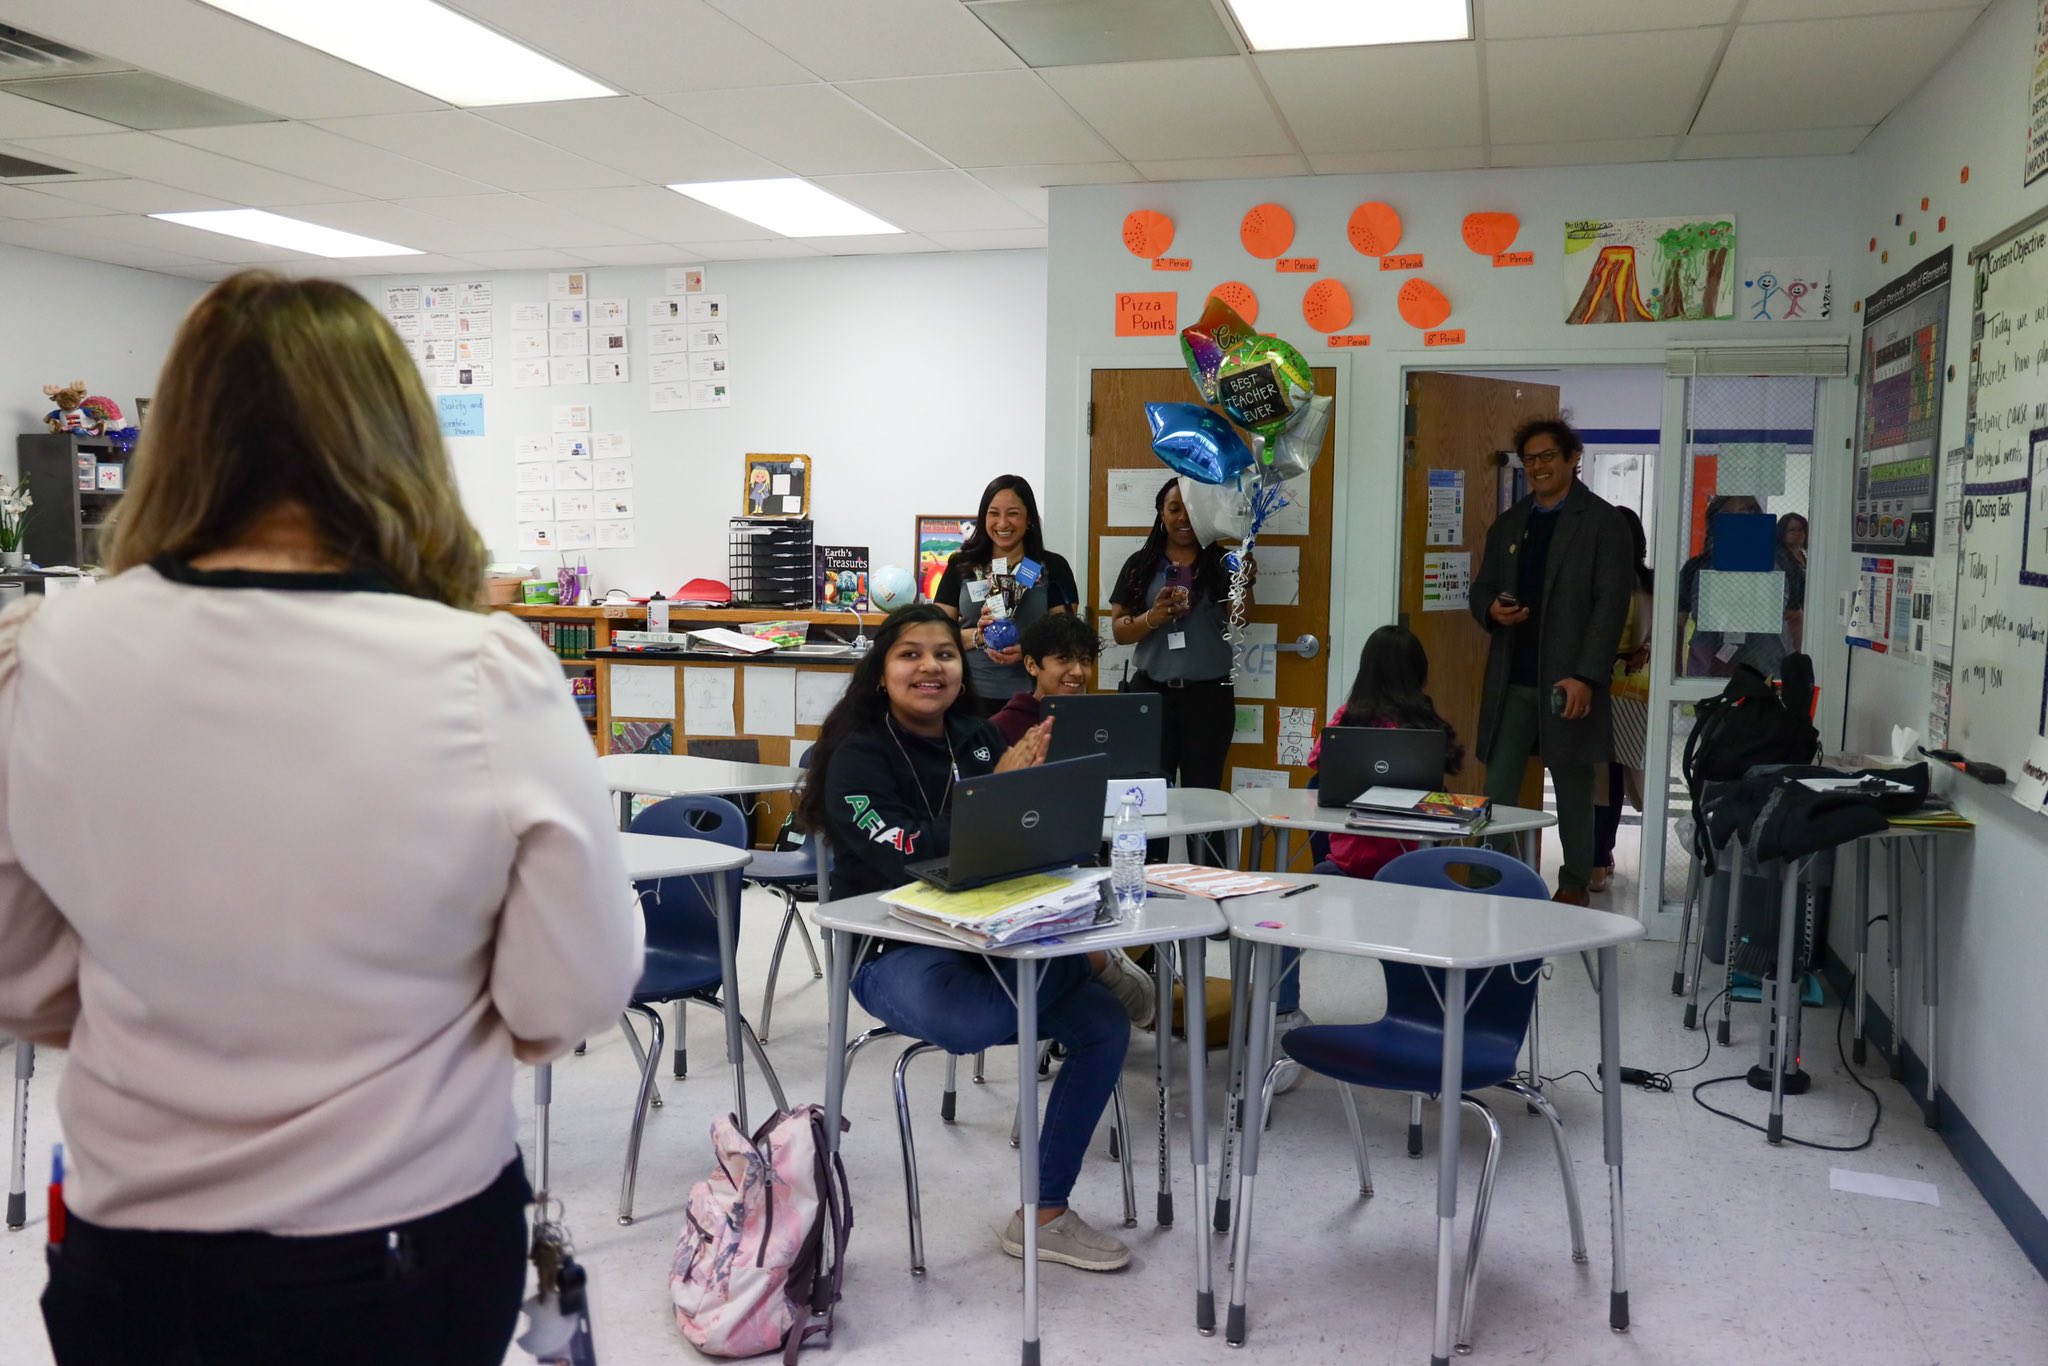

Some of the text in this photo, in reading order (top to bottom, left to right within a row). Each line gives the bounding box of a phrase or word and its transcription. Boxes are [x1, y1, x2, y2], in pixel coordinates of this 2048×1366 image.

[1169, 258, 1190, 267] Period
[1400, 258, 1423, 269] Period
[1509, 253, 1533, 263] Period
[1989, 232, 2047, 275] Content Objective:
[1294, 259, 1316, 270] Period
[1922, 261, 1949, 286] Elements
[1121, 295, 1161, 311] Pizza
[1132, 313, 1174, 330] Points
[1987, 312, 2012, 346] Today
[2017, 313, 2028, 331] we
[1347, 336, 1367, 346] Period
[2014, 351, 2030, 374] how
[1230, 373, 1258, 393] BEST
[1225, 383, 1278, 408] TEACHER
[1243, 403, 1276, 423] EVER
[1975, 498, 1997, 522] Closing
[825, 548, 852, 557] Earth's
[827, 556, 868, 568] Treasures
[1969, 552, 1988, 598] Today
[1961, 604, 1976, 631] will
[1981, 608, 2007, 638] complete
[1962, 665, 1969, 684] in
[1973, 665, 1986, 696] my
[1990, 666, 2003, 688] ISN
